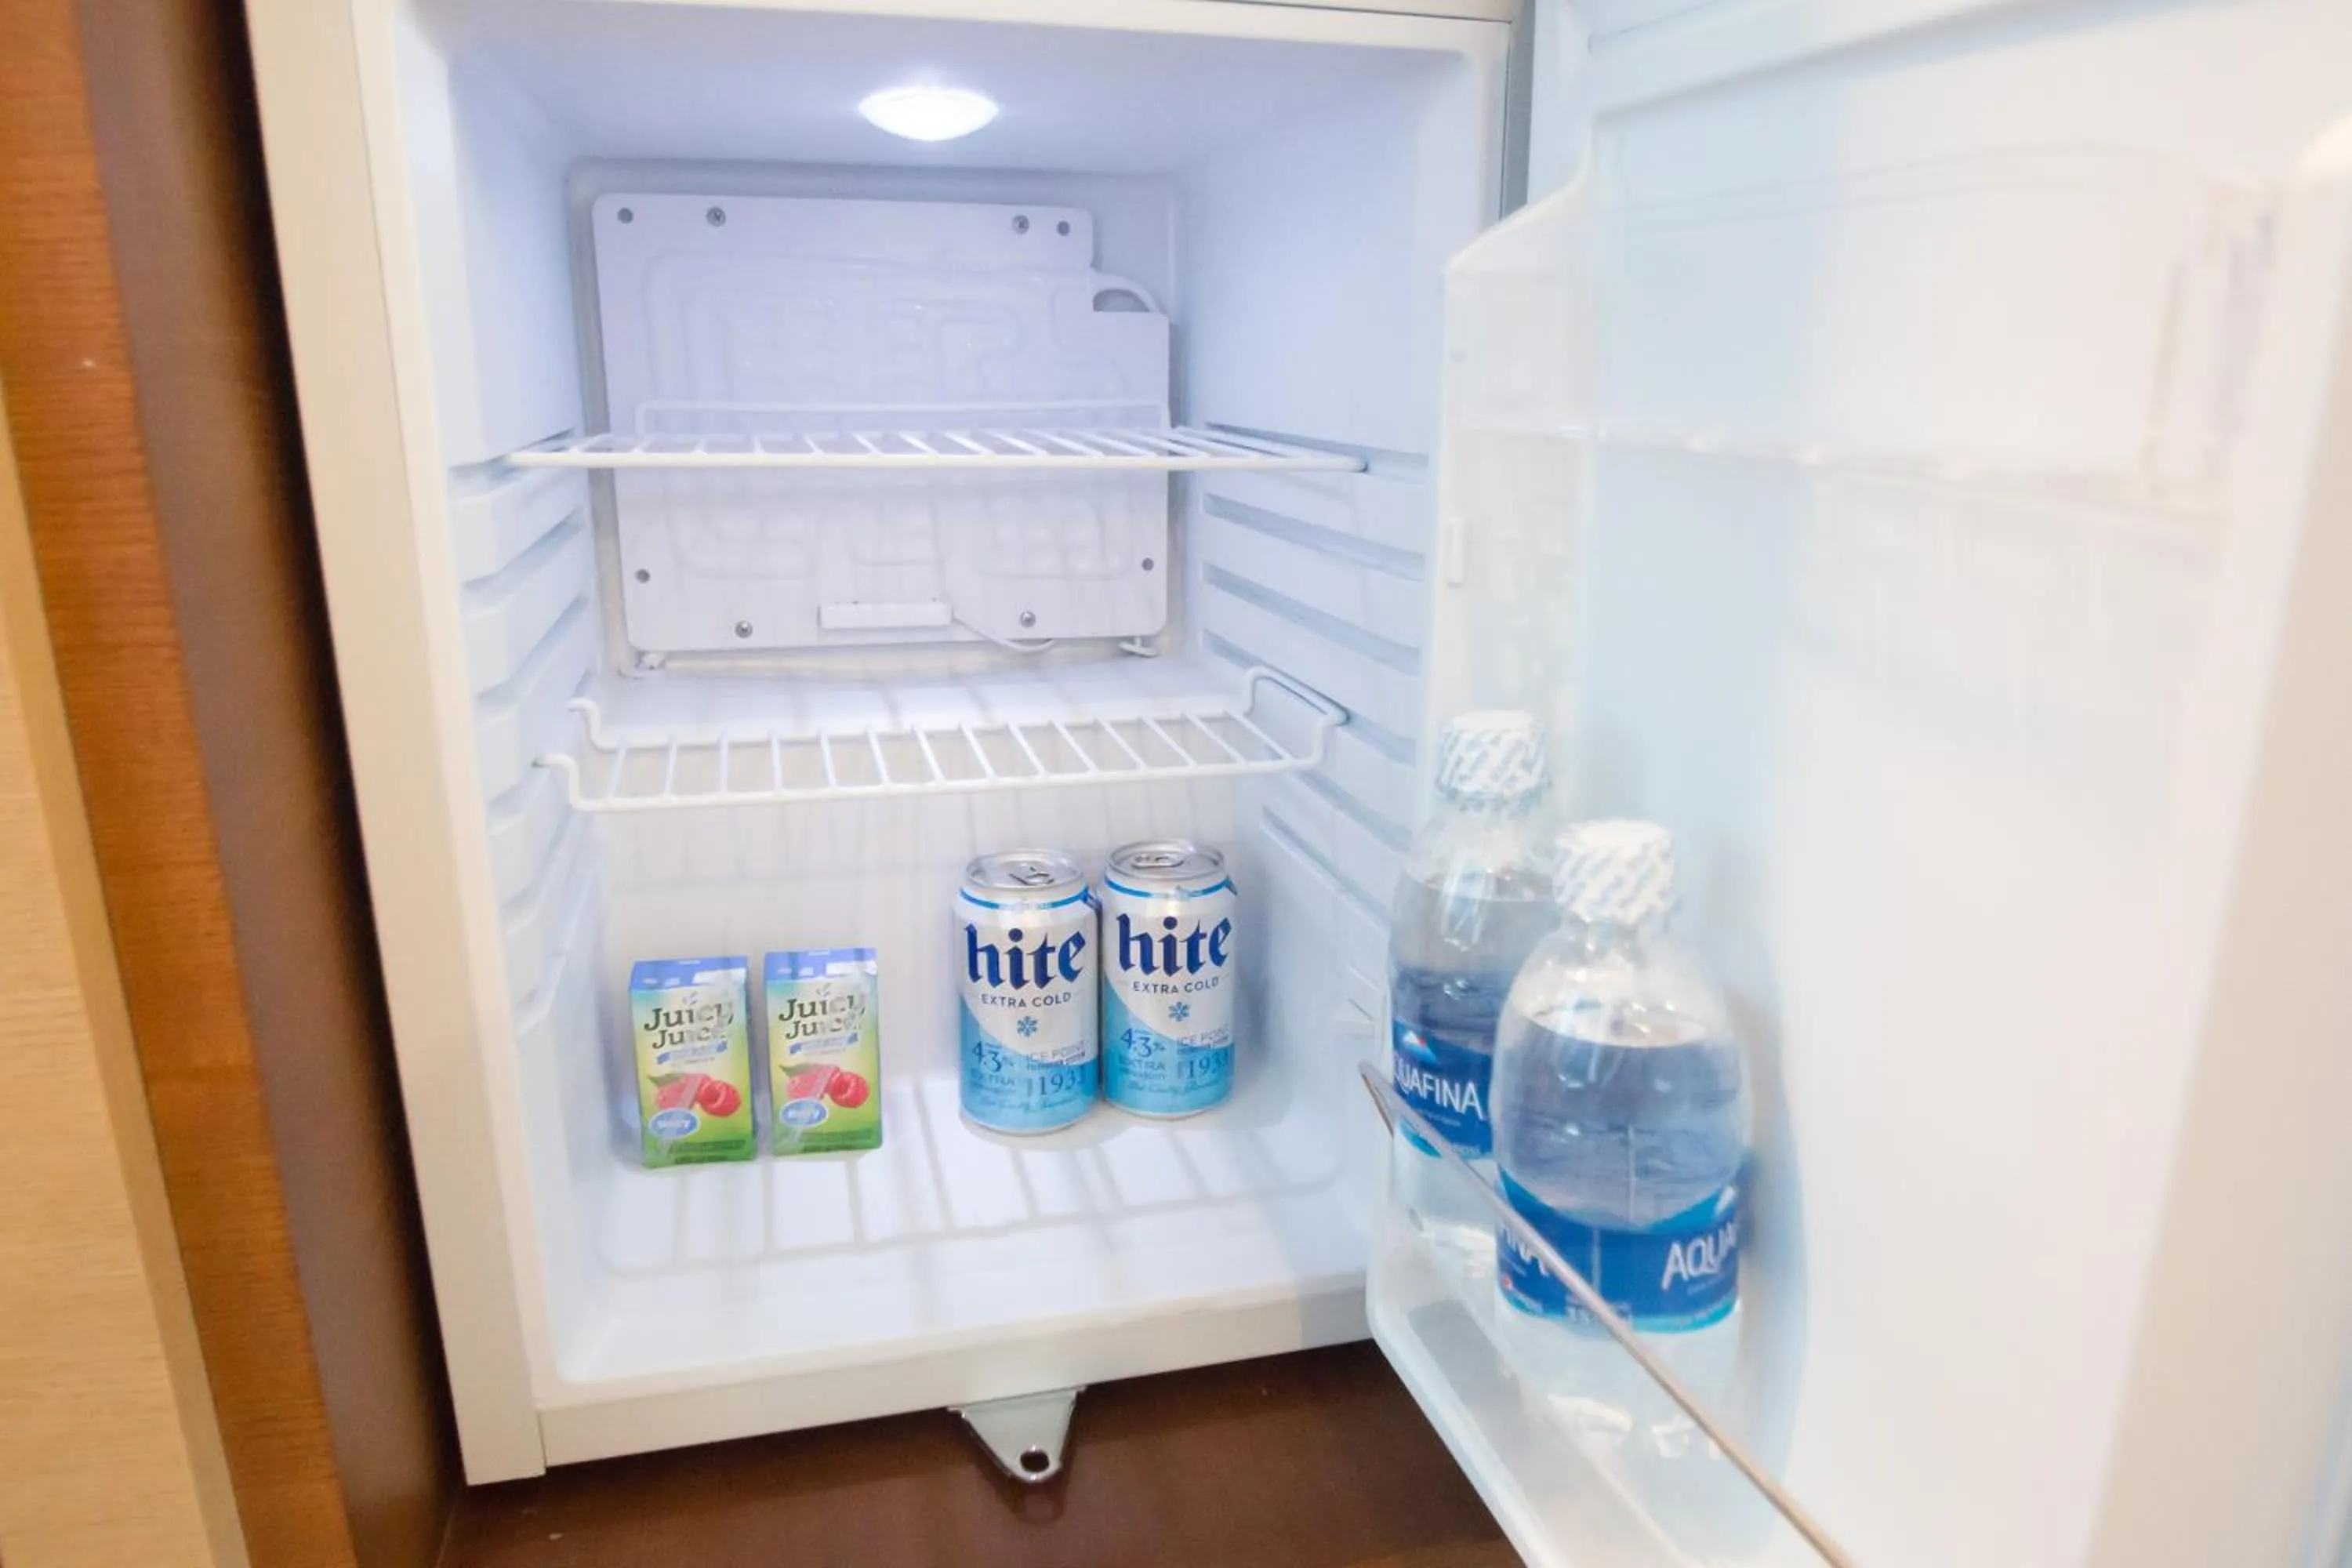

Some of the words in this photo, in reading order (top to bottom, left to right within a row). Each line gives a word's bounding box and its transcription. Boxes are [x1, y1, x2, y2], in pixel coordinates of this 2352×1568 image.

[964, 923, 1086, 990] hite
[1116, 913, 1232, 978] hite
[981, 993, 1027, 1008] EXTRA
[1032, 991, 1073, 1008] COLD
[1133, 980, 1178, 995] EXTRA
[1184, 978, 1220, 993] COLD
